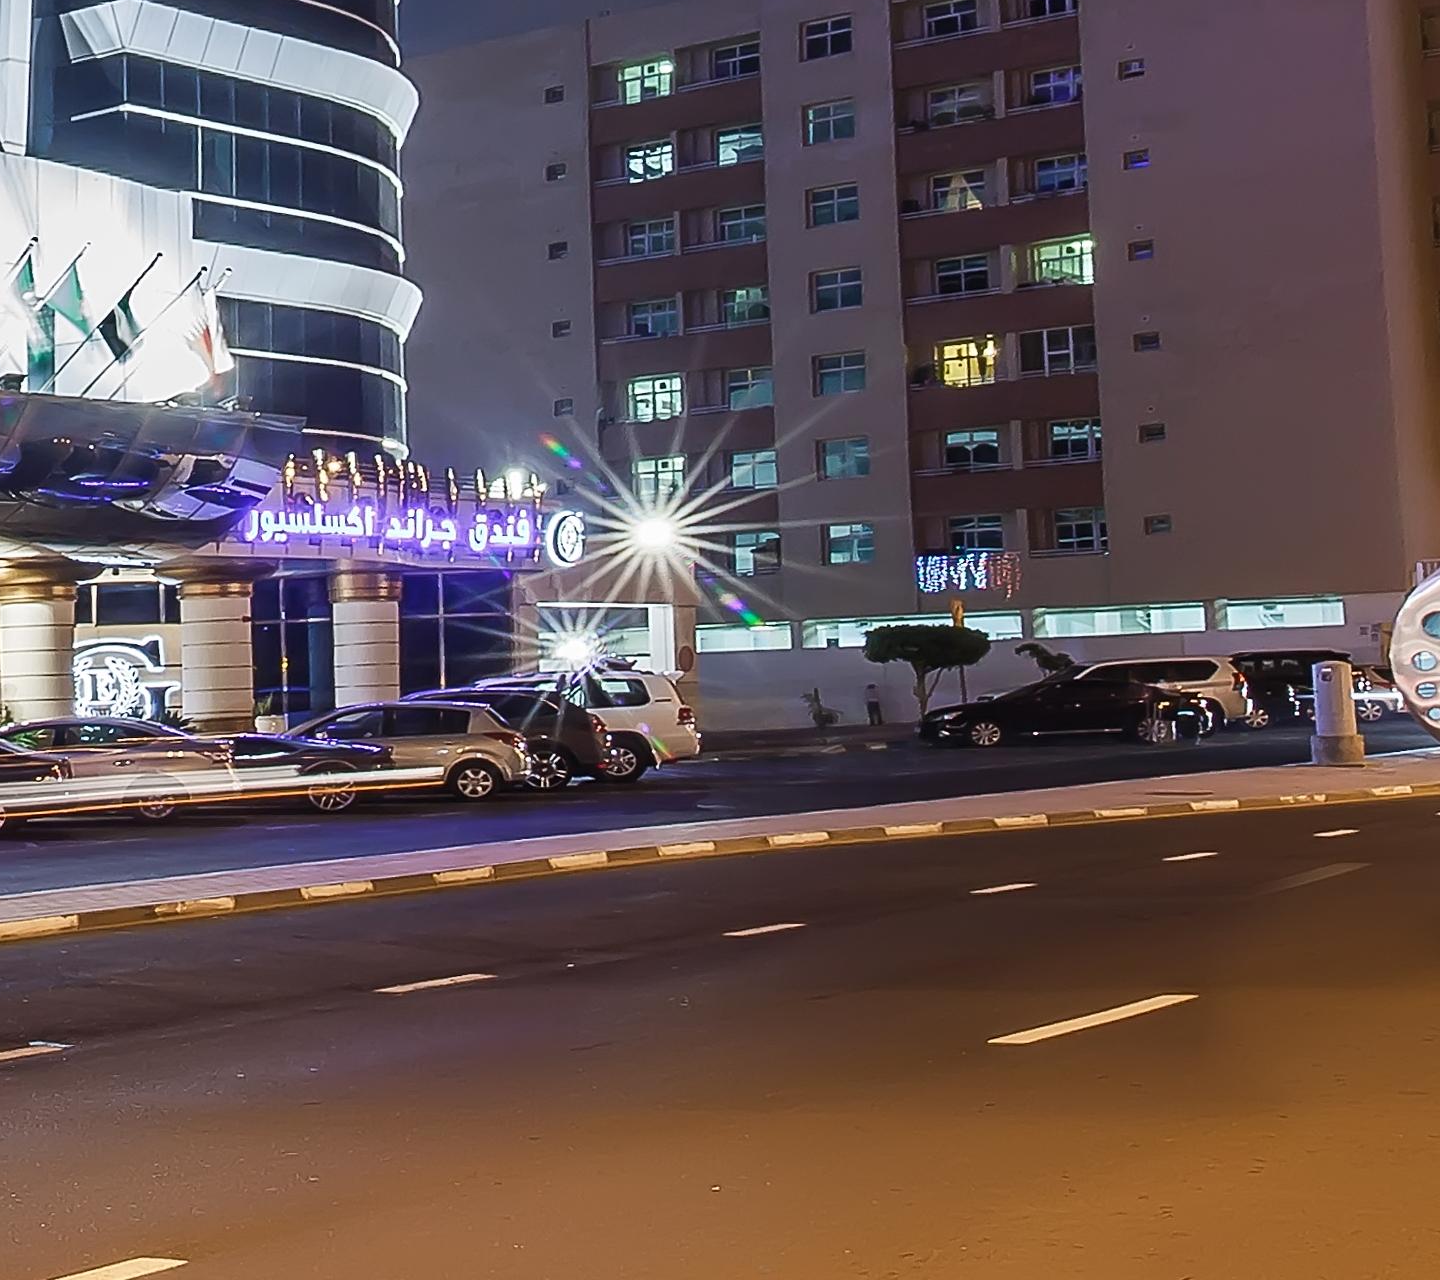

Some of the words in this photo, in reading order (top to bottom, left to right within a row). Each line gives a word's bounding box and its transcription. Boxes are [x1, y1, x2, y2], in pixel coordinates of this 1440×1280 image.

[245, 504, 374, 543] اكسلسيور
[385, 507, 458, 550] جراند
[469, 508, 532, 551] فندق
